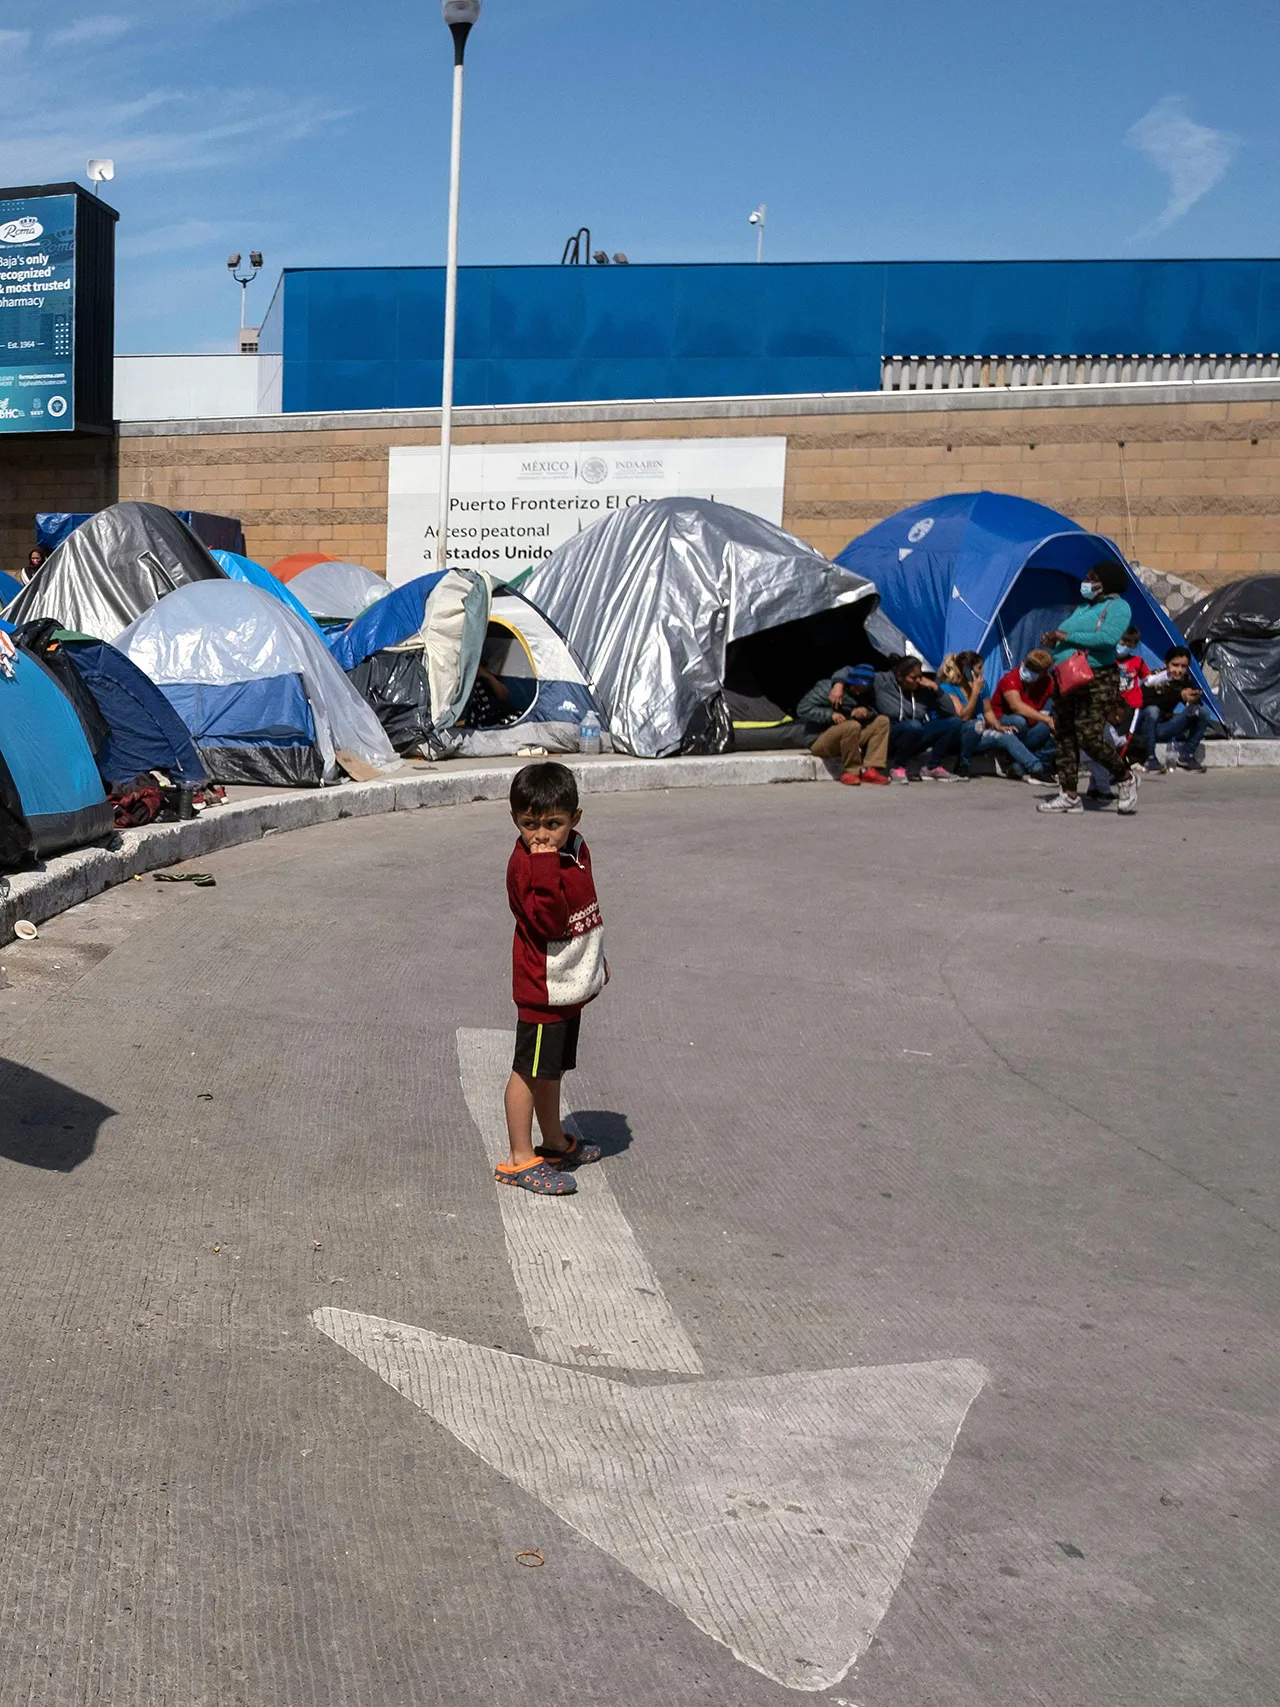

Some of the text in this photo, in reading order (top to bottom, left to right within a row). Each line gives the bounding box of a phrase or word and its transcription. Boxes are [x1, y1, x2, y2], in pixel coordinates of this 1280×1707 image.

[4, 224, 35, 238] Roma
[26, 253, 49, 266] only
[6, 283, 32, 293] most
[33, 279, 70, 291] trusted
[521, 460, 569, 472] MÉXICO
[450, 498, 506, 511] Puerto
[512, 495, 600, 511] Fronterizo
[606, 495, 619, 509] El
[481, 524, 549, 540] peatonal
[424, 546, 553, 559] a stados Unido
